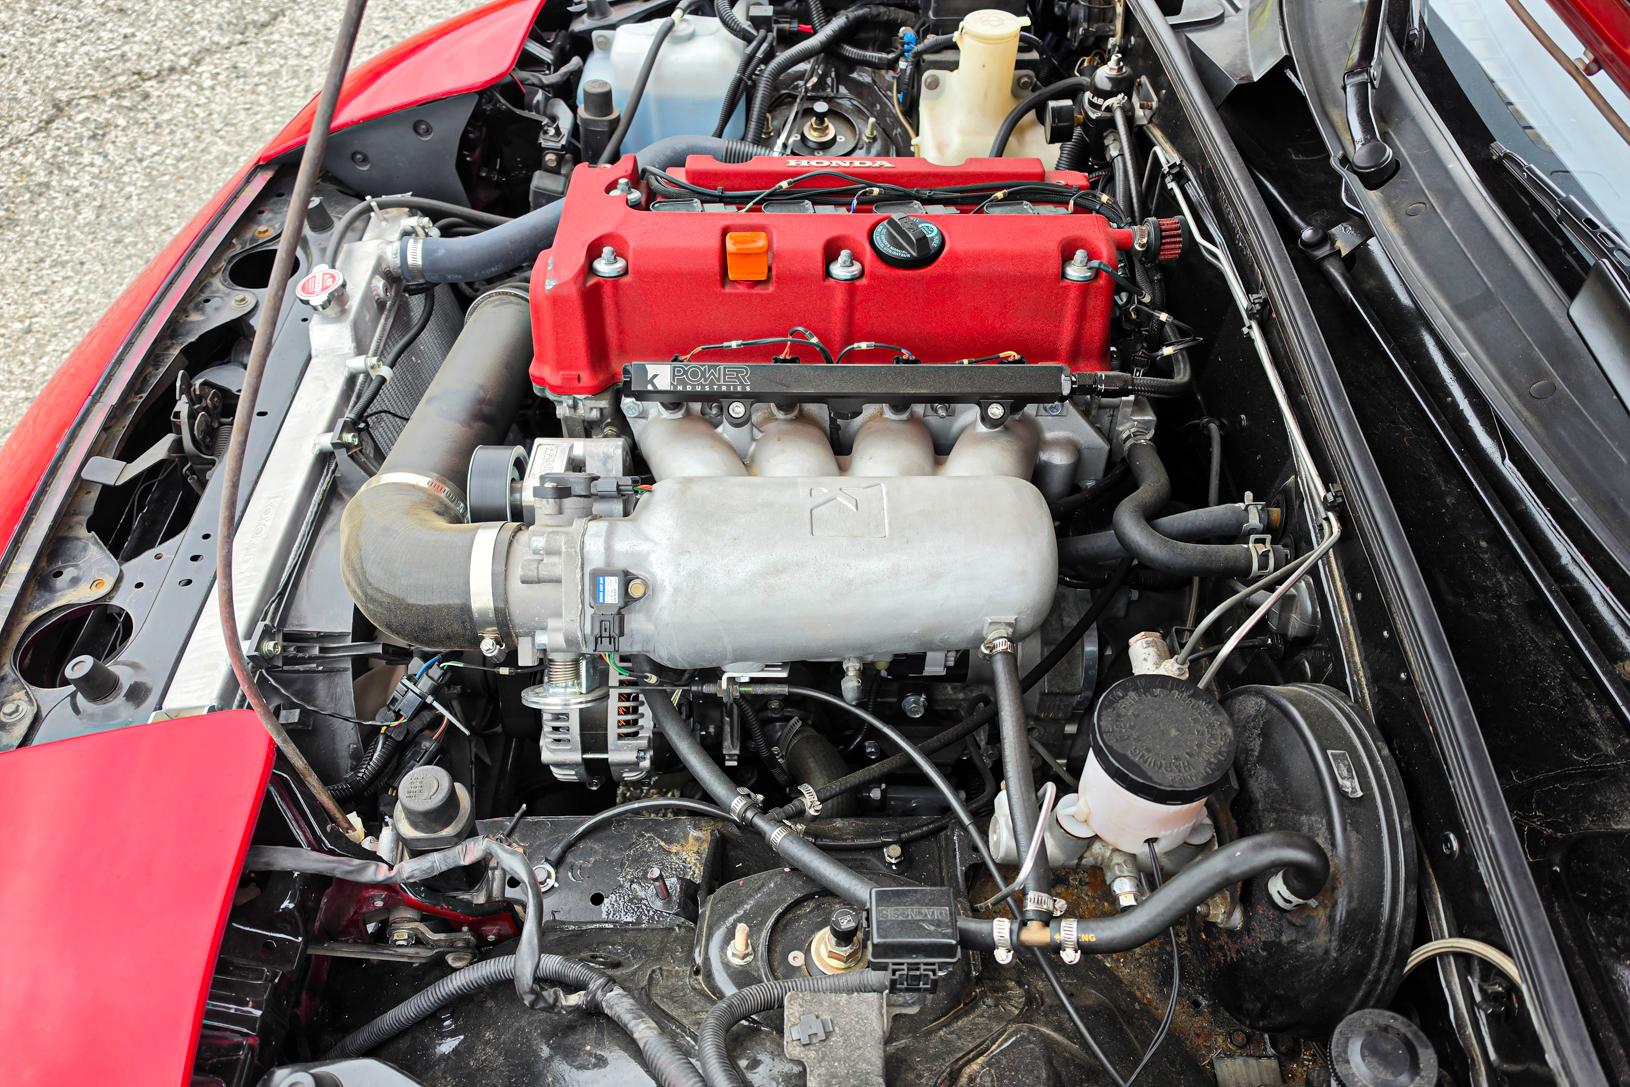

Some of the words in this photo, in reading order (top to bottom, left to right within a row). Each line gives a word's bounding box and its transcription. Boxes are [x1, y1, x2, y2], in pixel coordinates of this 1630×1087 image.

[787, 159, 895, 168] HONDA
[645, 364, 671, 391] K
[671, 364, 751, 385] POWER
